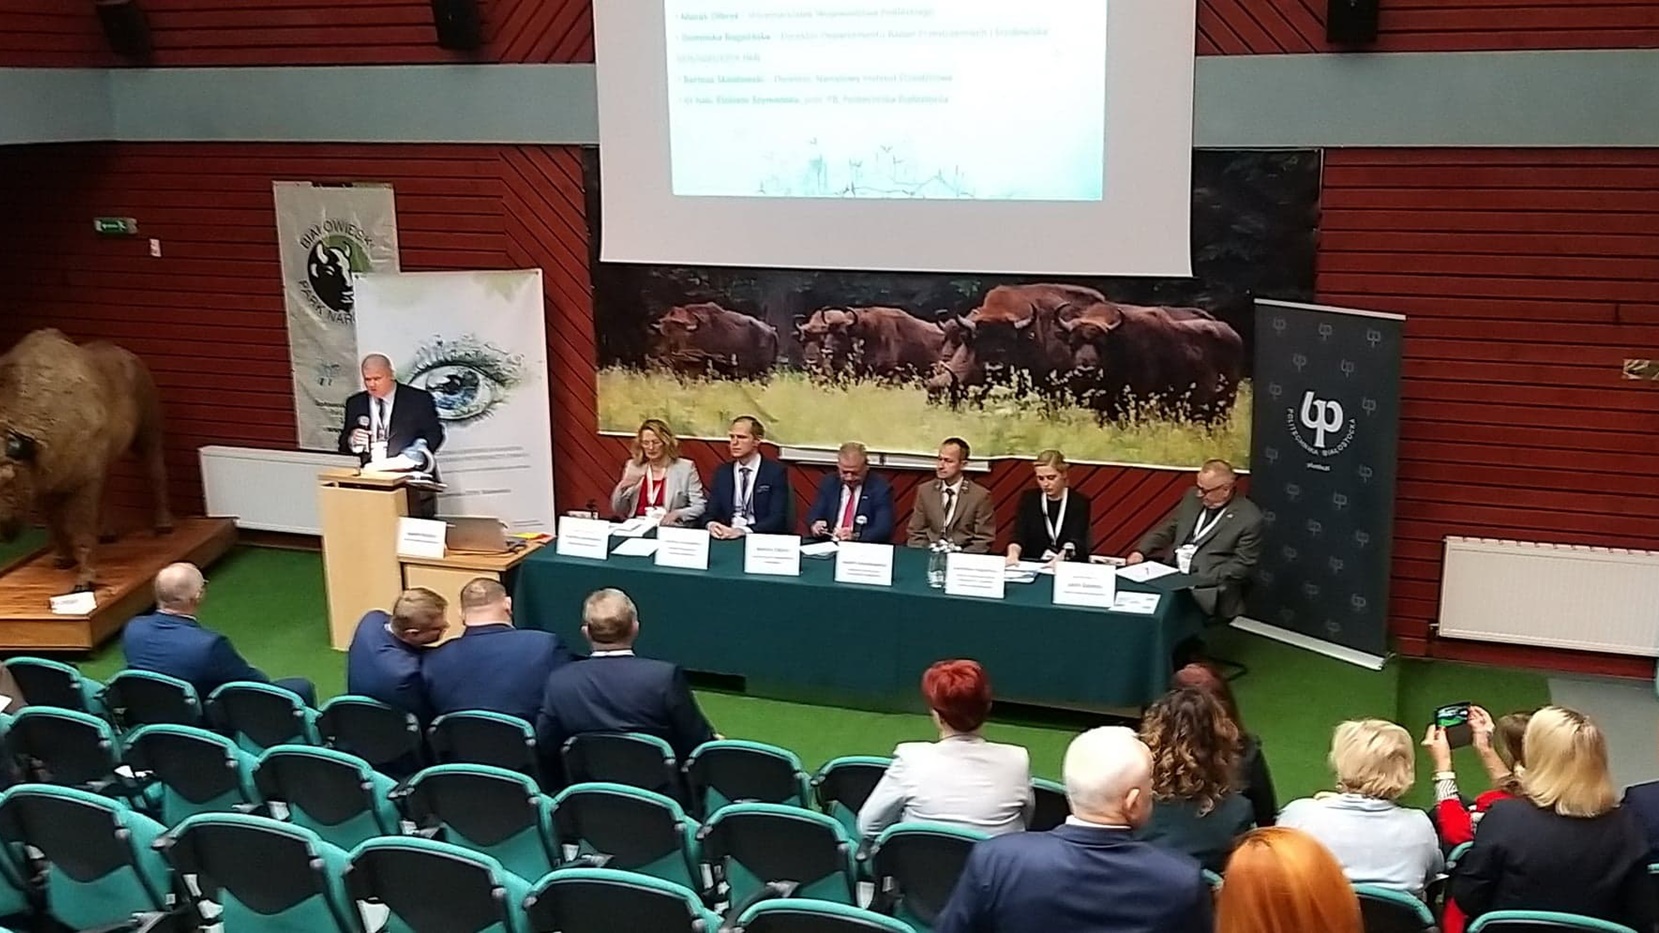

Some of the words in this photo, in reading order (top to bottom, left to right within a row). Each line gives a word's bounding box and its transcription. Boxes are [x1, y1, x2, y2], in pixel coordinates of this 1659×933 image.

[298, 280, 326, 315] PARK
[1287, 407, 1319, 456] POLITECHNIKA
[1322, 419, 1356, 457] BIAŁOSTOCKA
